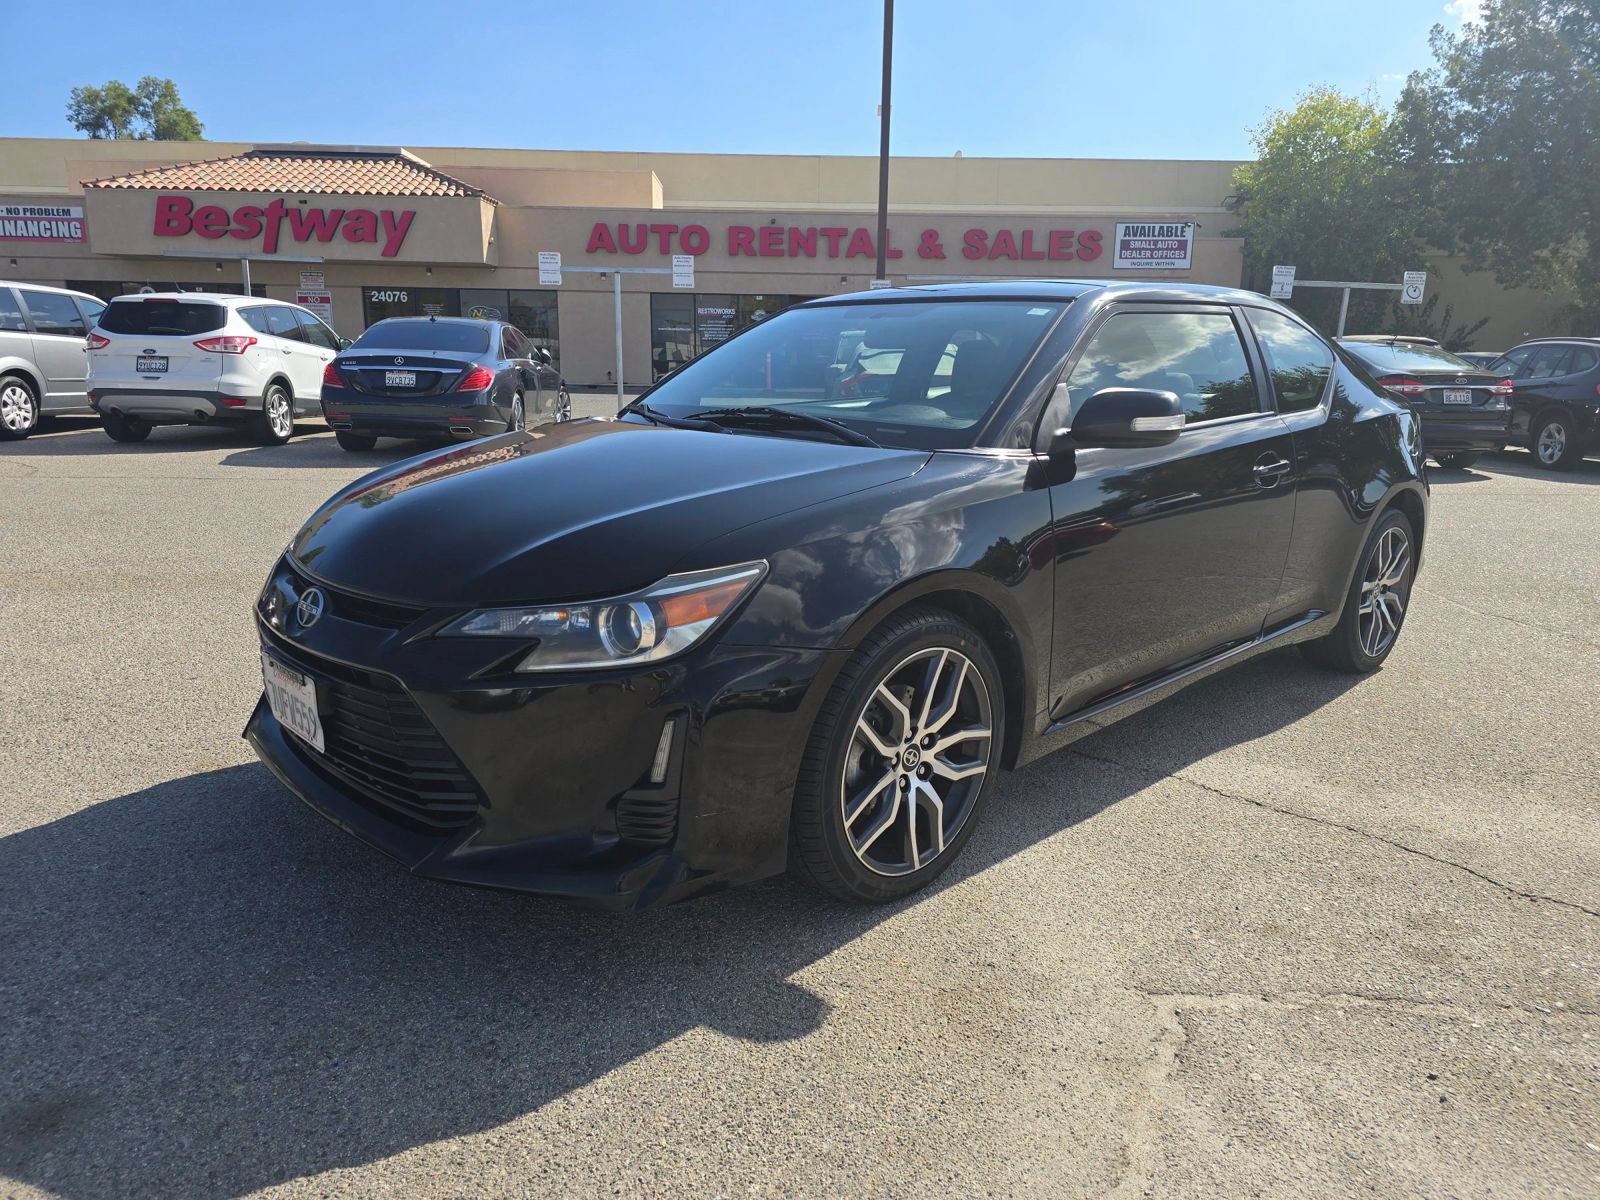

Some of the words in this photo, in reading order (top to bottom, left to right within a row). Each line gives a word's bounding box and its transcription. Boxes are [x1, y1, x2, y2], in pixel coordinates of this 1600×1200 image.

[5, 207, 20, 216] NO
[22, 207, 71, 217] PROBLEM
[153, 196, 416, 257] Bestway
[1123, 225, 1187, 238] AVAILABLE
[587, 223, 710, 255] AUTO
[727, 225, 903, 258] RENTAL
[918, 228, 947, 259] &
[962, 229, 1103, 261] SALES
[1130, 241, 1155, 249] SMALL
[1157, 241, 1178, 249] AUTO
[1121, 250, 1151, 258] DEALER
[1153, 250, 1185, 258] OFFICES
[371, 291, 408, 302] 24076
